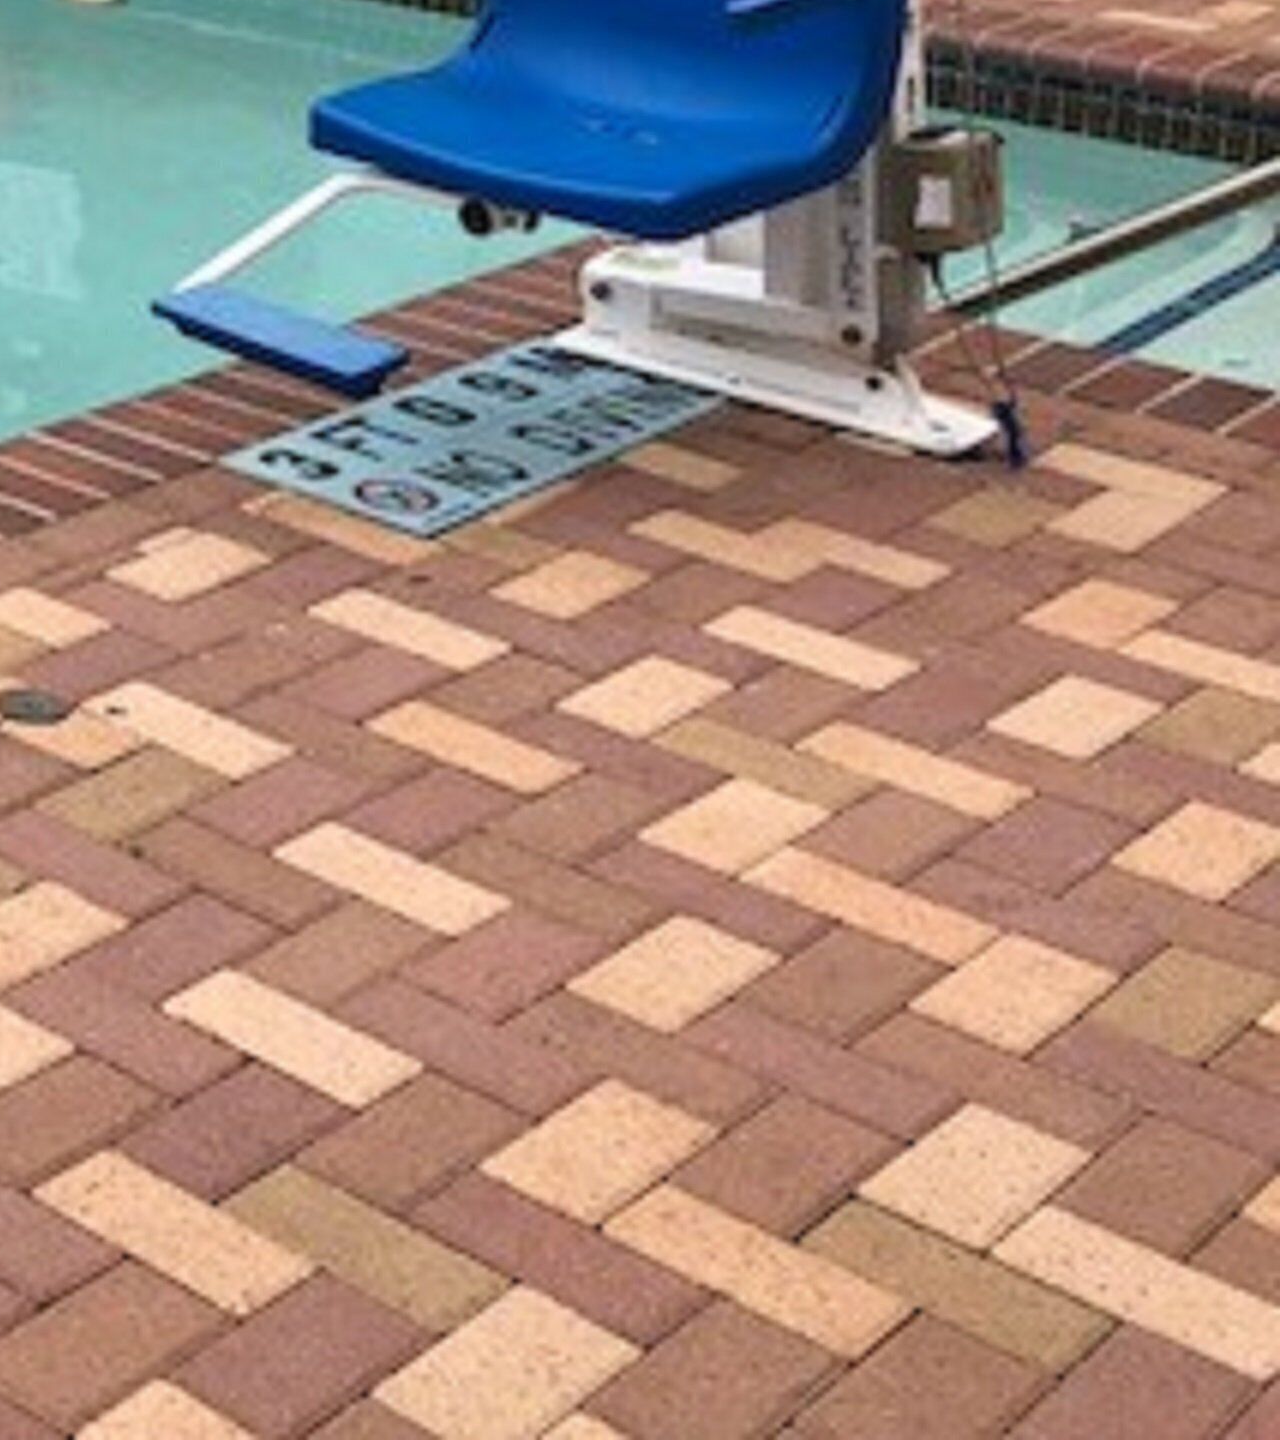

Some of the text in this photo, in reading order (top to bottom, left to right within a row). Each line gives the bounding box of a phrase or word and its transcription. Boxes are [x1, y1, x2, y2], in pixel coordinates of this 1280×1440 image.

[258, 447, 341, 481] 3
[307, 416, 421, 462] FT
[391, 395, 478, 427] 0
[457, 371, 539, 402] 9
[412, 449, 531, 497] NO
